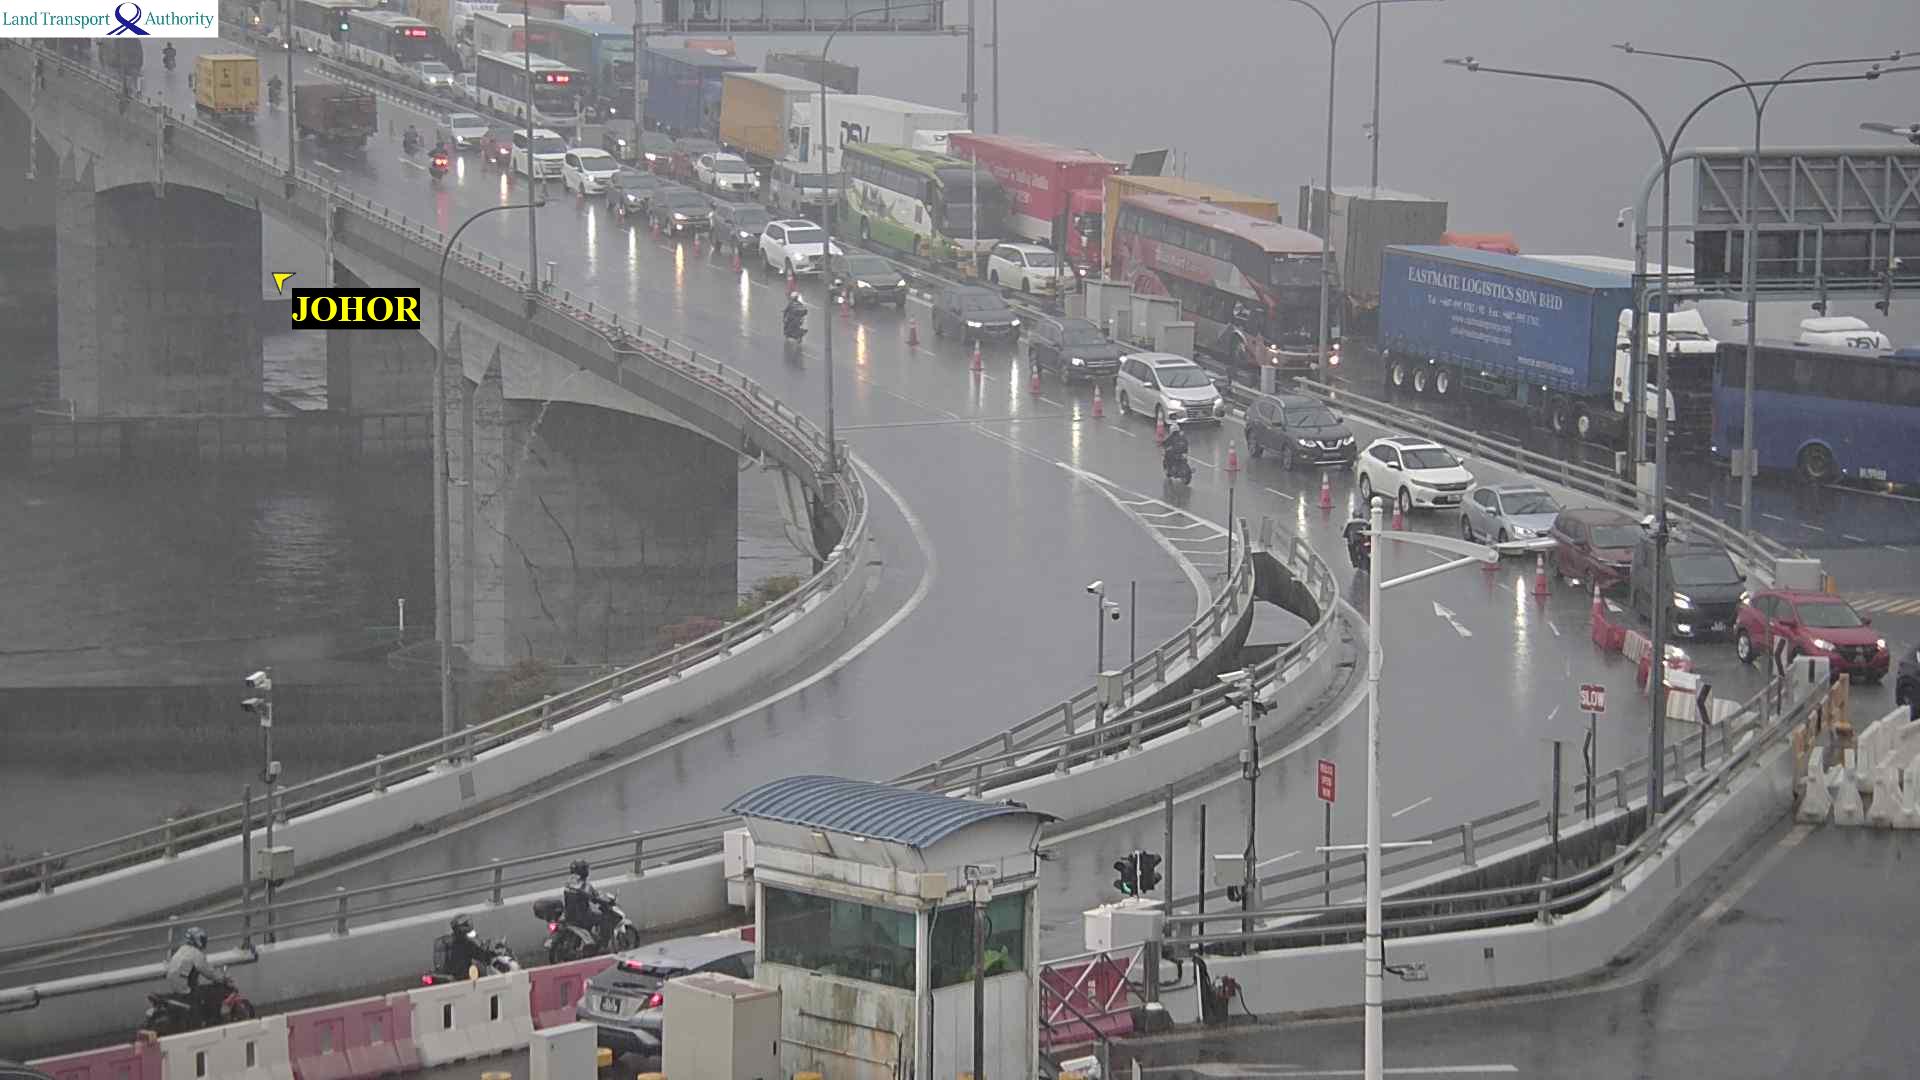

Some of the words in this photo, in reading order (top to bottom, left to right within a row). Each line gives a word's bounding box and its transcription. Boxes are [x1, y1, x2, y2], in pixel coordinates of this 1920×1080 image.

[1408, 266, 1461, 290] EASTMATE
[1461, 277, 1514, 301] LOGISTICS
[1514, 287, 1538, 305] SDN
[1539, 292, 1563, 310] BHD
[1846, 336, 1880, 350] DSV
[1580, 690, 1604, 707] SLOW
